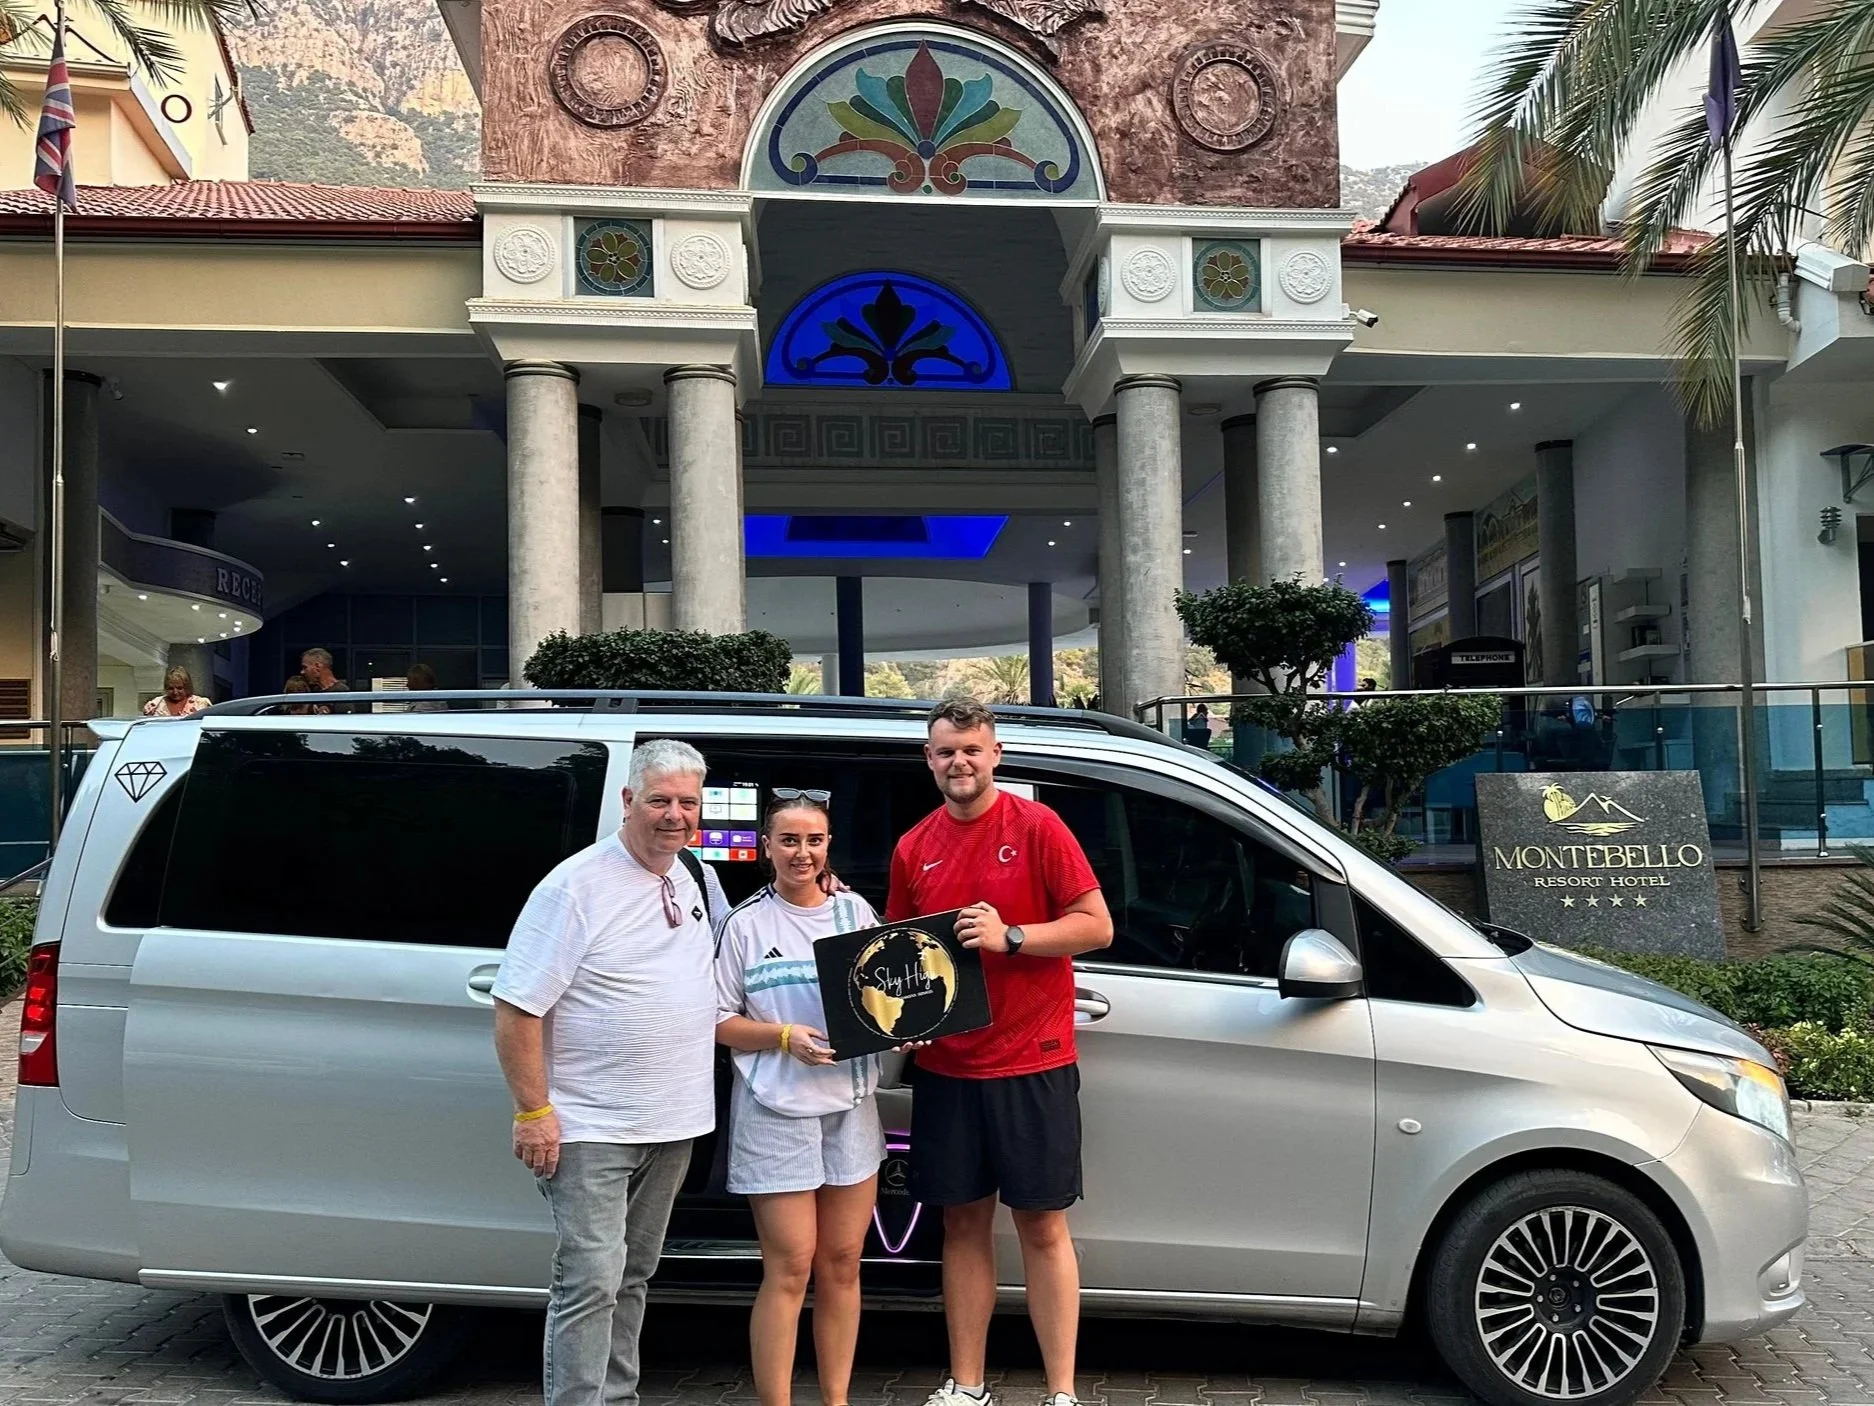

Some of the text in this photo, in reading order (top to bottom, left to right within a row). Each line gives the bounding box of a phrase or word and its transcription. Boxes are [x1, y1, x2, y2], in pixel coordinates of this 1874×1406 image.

[1459, 654, 1510, 662] TELEPHONE
[1493, 844, 1703, 870] MONTEBELLO
[1534, 875, 1671, 888] RESORT HOTEL
[874, 966, 902, 997] Sky
